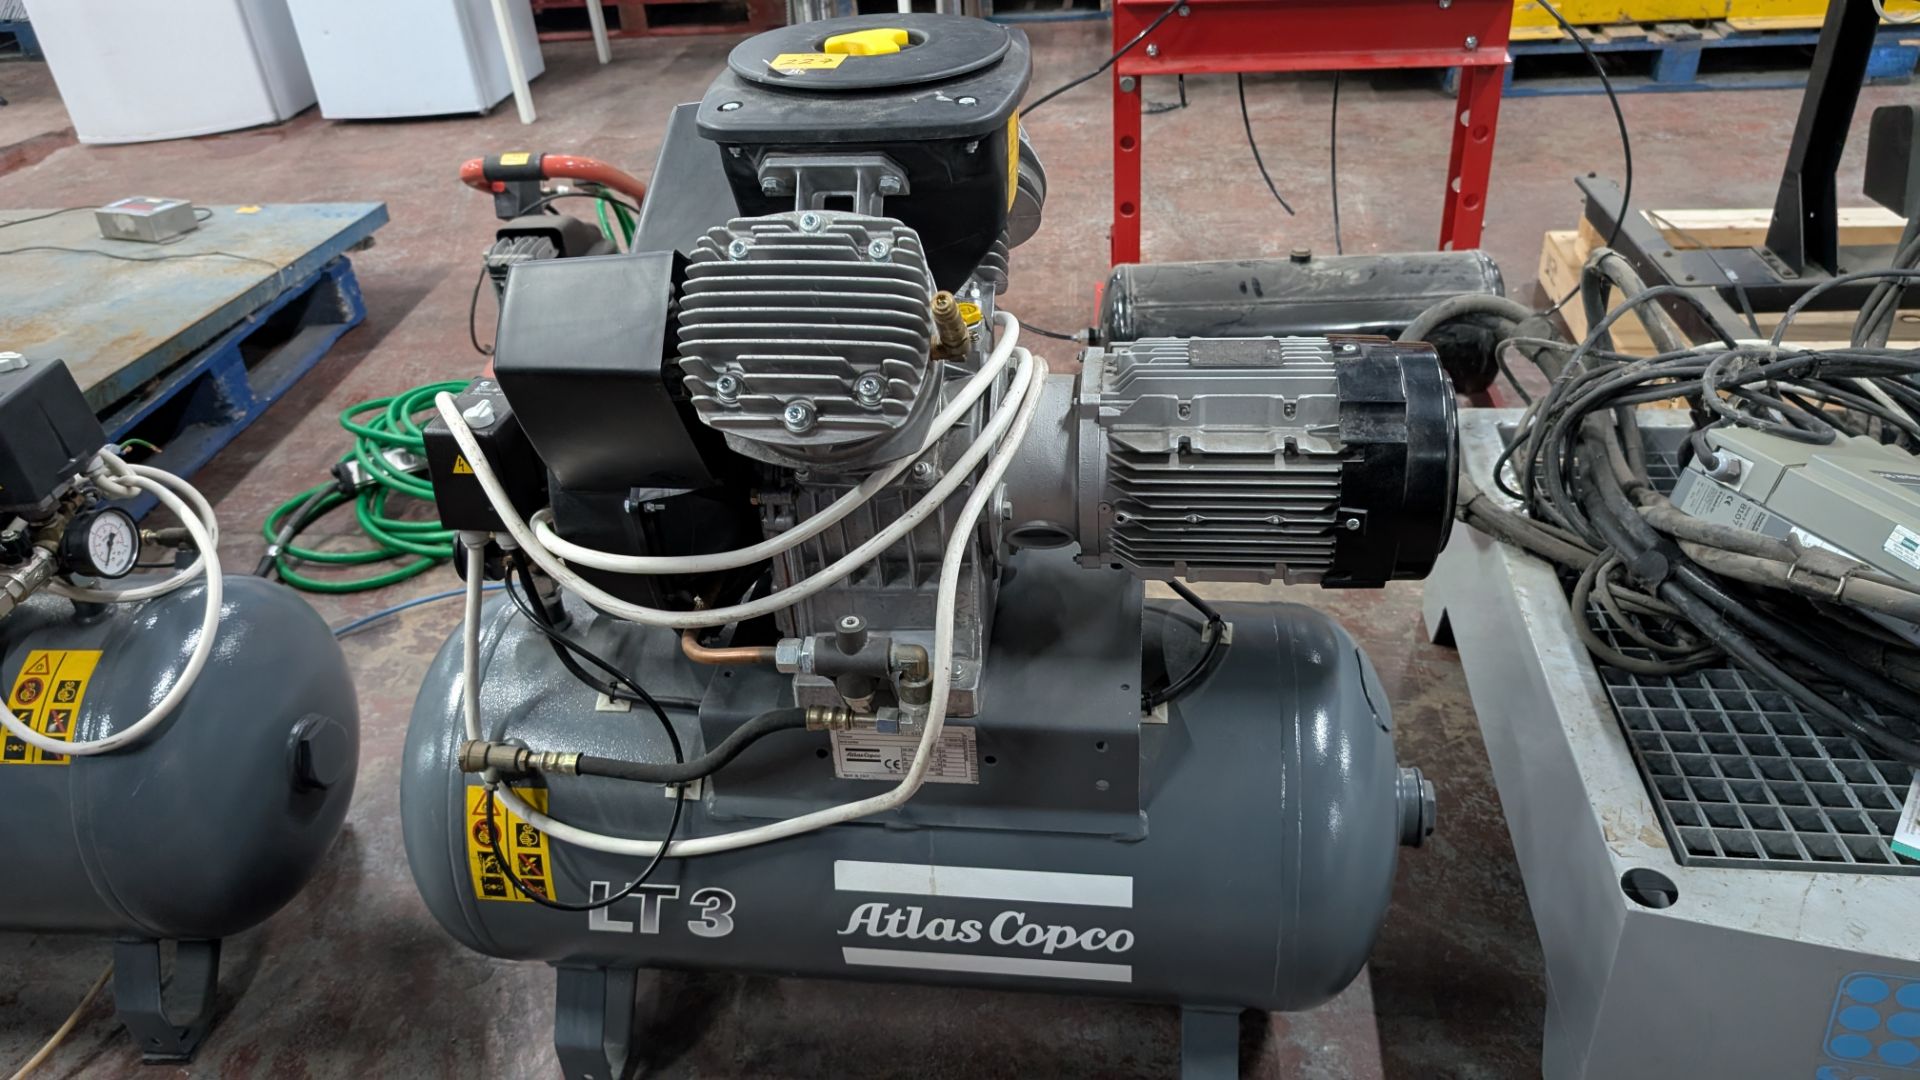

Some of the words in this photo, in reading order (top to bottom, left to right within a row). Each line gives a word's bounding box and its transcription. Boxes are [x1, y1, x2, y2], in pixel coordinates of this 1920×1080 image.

[589, 881, 680, 934] LT
[687, 887, 736, 937] 3
[837, 902, 982, 943] Atlas
[989, 911, 1134, 954] Copco
